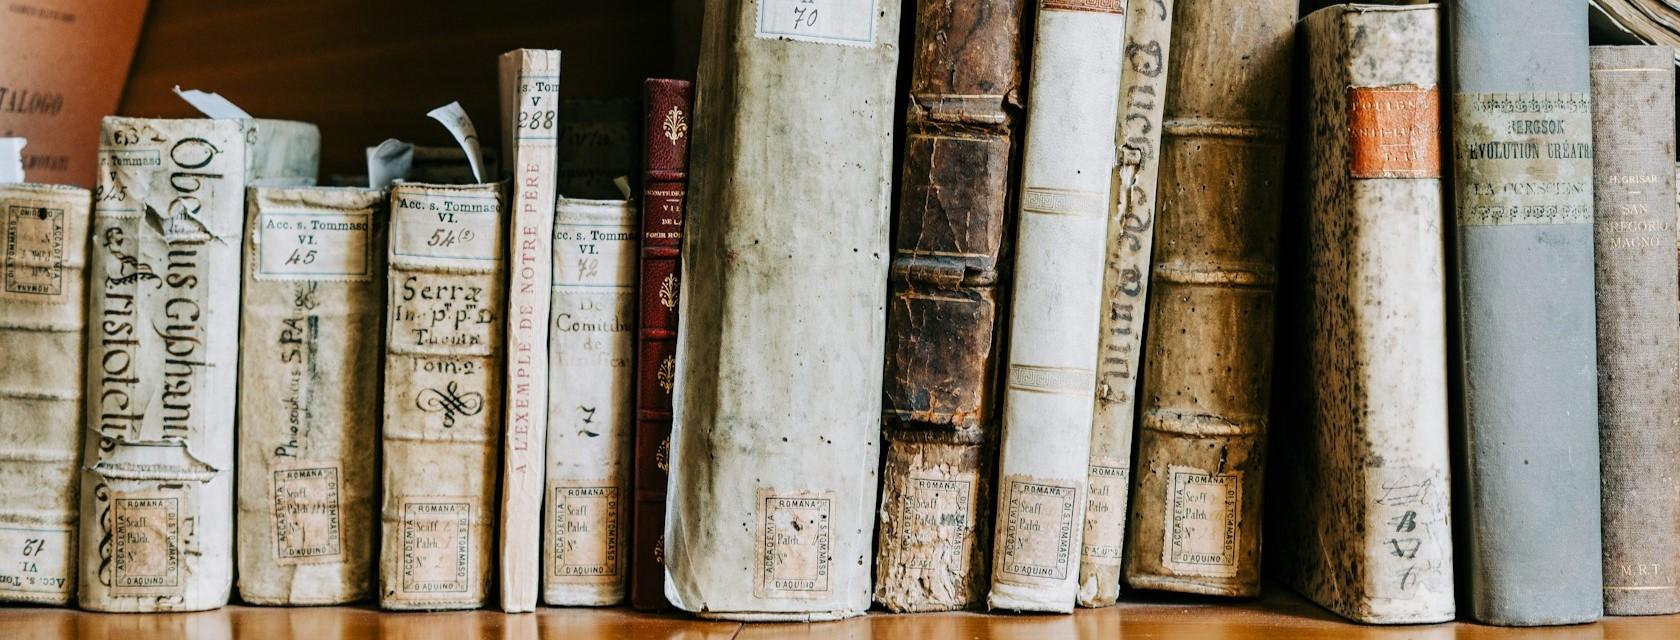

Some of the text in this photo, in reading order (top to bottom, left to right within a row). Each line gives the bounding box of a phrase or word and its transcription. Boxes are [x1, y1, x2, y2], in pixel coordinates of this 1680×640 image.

[794, 6, 818, 29] 70
[522, 84, 532, 92] s.
[531, 96, 541, 107] V
[517, 111, 555, 130] 288
[1621, 175, 1657, 184] GRISAR
[522, 163, 540, 213] PÈRE
[1473, 183, 1495, 195] LA
[400, 199, 500, 213] Acc. s. Tommaso
[1622, 204, 1649, 215] SAN
[438, 212, 459, 223] VI.
[266, 219, 368, 231] Acc. s. Tommaso
[298, 234, 318, 245] VI.
[576, 231, 586, 241] s.
[579, 244, 599, 255] VI.
[284, 248, 318, 265] 45
[520, 226, 537, 294] NOTRE
[519, 305, 534, 331] DE
[287, 470, 323, 479] ROMANA
[1091, 467, 1125, 477] ROMANA
[919, 481, 957, 490] ROMANA
[1187, 475, 1224, 484] ROMANA
[1024, 485, 1061, 496] ROMANA
[418, 505, 456, 513] ROMANA
[779, 500, 817, 508] ROMANA
[277, 487, 287, 542] ACCADEMIA
[328, 500, 338, 541] TOMMASO
[1174, 489, 1183, 547] ACCADEMIA
[556, 503, 565, 560] ACCADEMIA
[1007, 498, 1018, 557] ACCADEMIA
[1225, 509, 1234, 550] TOMMASO
[118, 515, 126, 571] ACCADEMIA
[608, 521, 616, 561] TOMMASO
[766, 514, 774, 574] ACCADEMIA
[1058, 522, 1070, 564] TOMMASO
[23, 538, 45, 557] 12
[458, 536, 466, 578] TOMMASO
[819, 533, 827, 576] TOMMASO
[1183, 554, 1221, 563] D'AQUINO
[19, 561, 38, 573] VI.
[1014, 564, 1053, 576] D'AQUINO
[26, 577, 36, 585] s.
[40, 577, 66, 589] Acc.
